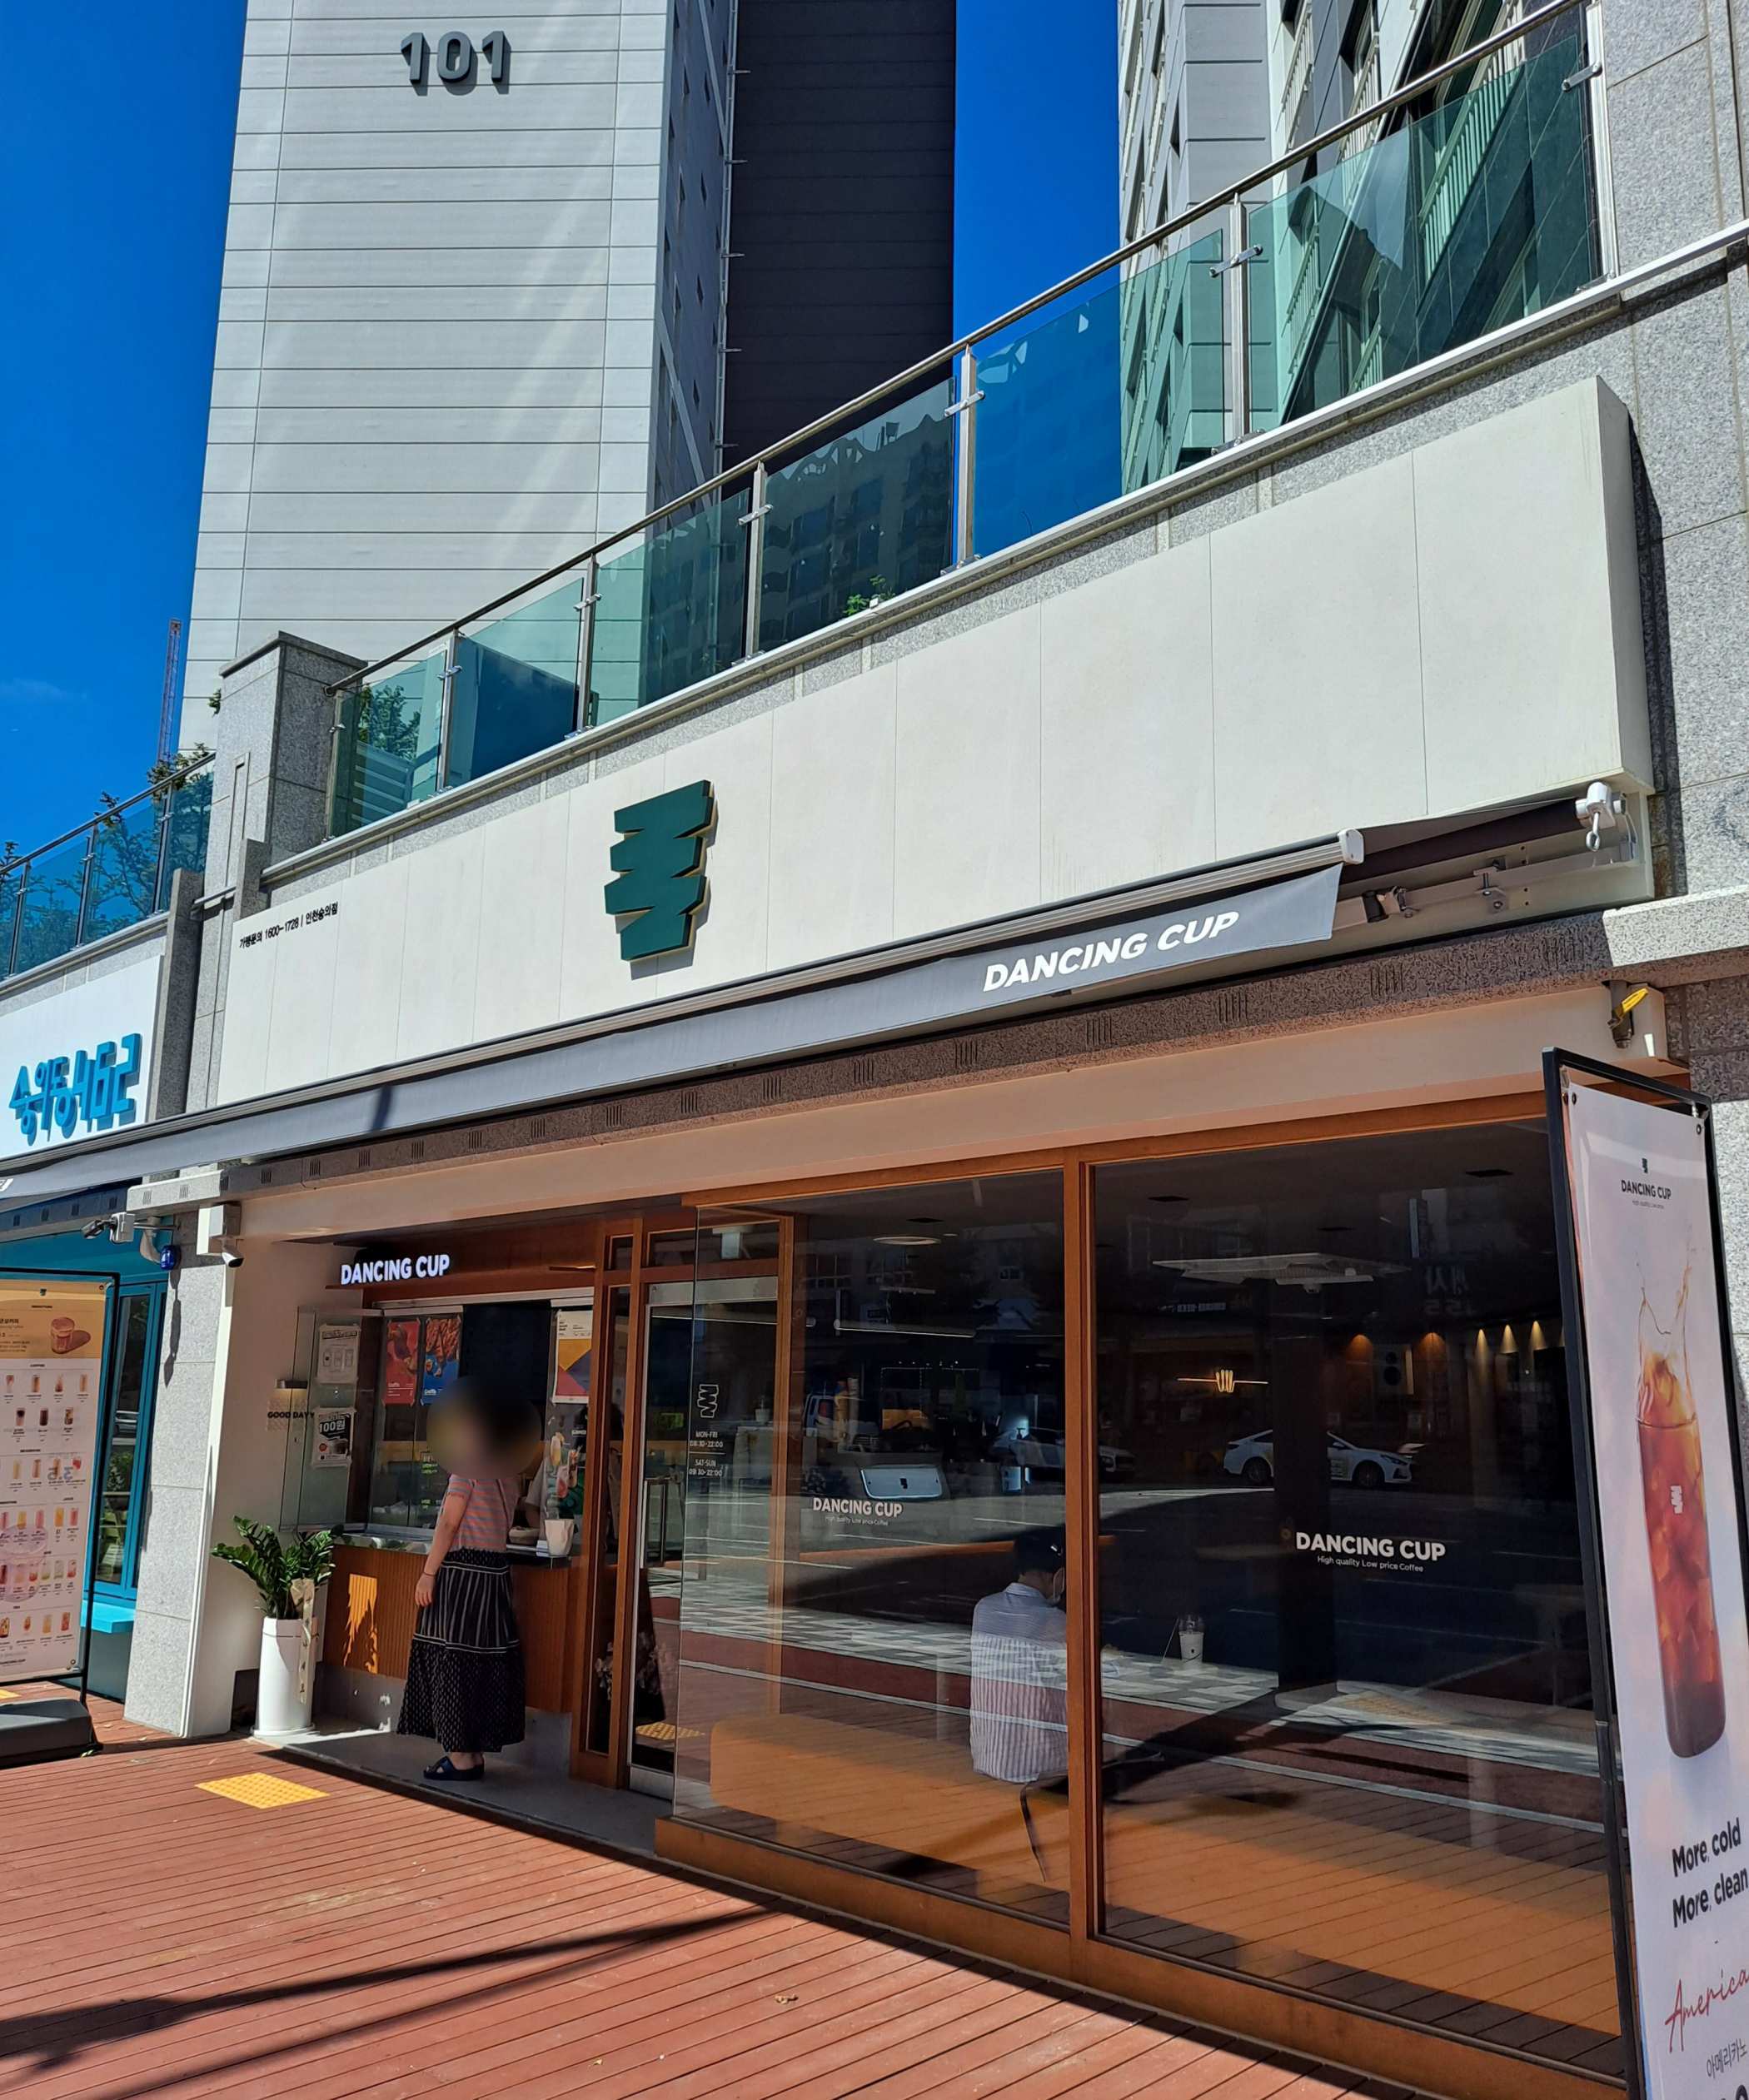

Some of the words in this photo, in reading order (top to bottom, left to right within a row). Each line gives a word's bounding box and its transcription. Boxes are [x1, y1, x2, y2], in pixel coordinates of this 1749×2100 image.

[401, 31, 505, 82] 101
[239, 930, 263, 948] 가맹문의
[265, 917, 299, 939] 1600-1728
[983, 933, 1148, 992] DANCING
[1157, 911, 1239, 951] CUP
[1621, 1179, 1657, 1197] DANCING
[1657, 1187, 1672, 1199] CUP
[341, 1257, 412, 1285] DANCING
[416, 1254, 450, 1278] CUP
[813, 1497, 872, 1515] DANCING
[874, 1502, 903, 1518] CUP
[1296, 1532, 1394, 1558] DANCING
[1399, 1540, 1446, 1561] CUP
[1318, 1555, 1334, 1565] High
[1335, 1558, 1360, 1567] quality
[1362, 1560, 1378, 1568] Low
[1379, 1561, 1398, 1570] price
[1399, 1563, 1423, 1572] Coffee
[1712, 1817, 1742, 1856] cold
[1714, 1868, 1748, 1905] clean
[1707, 2038, 1748, 2078] 아메리카노
